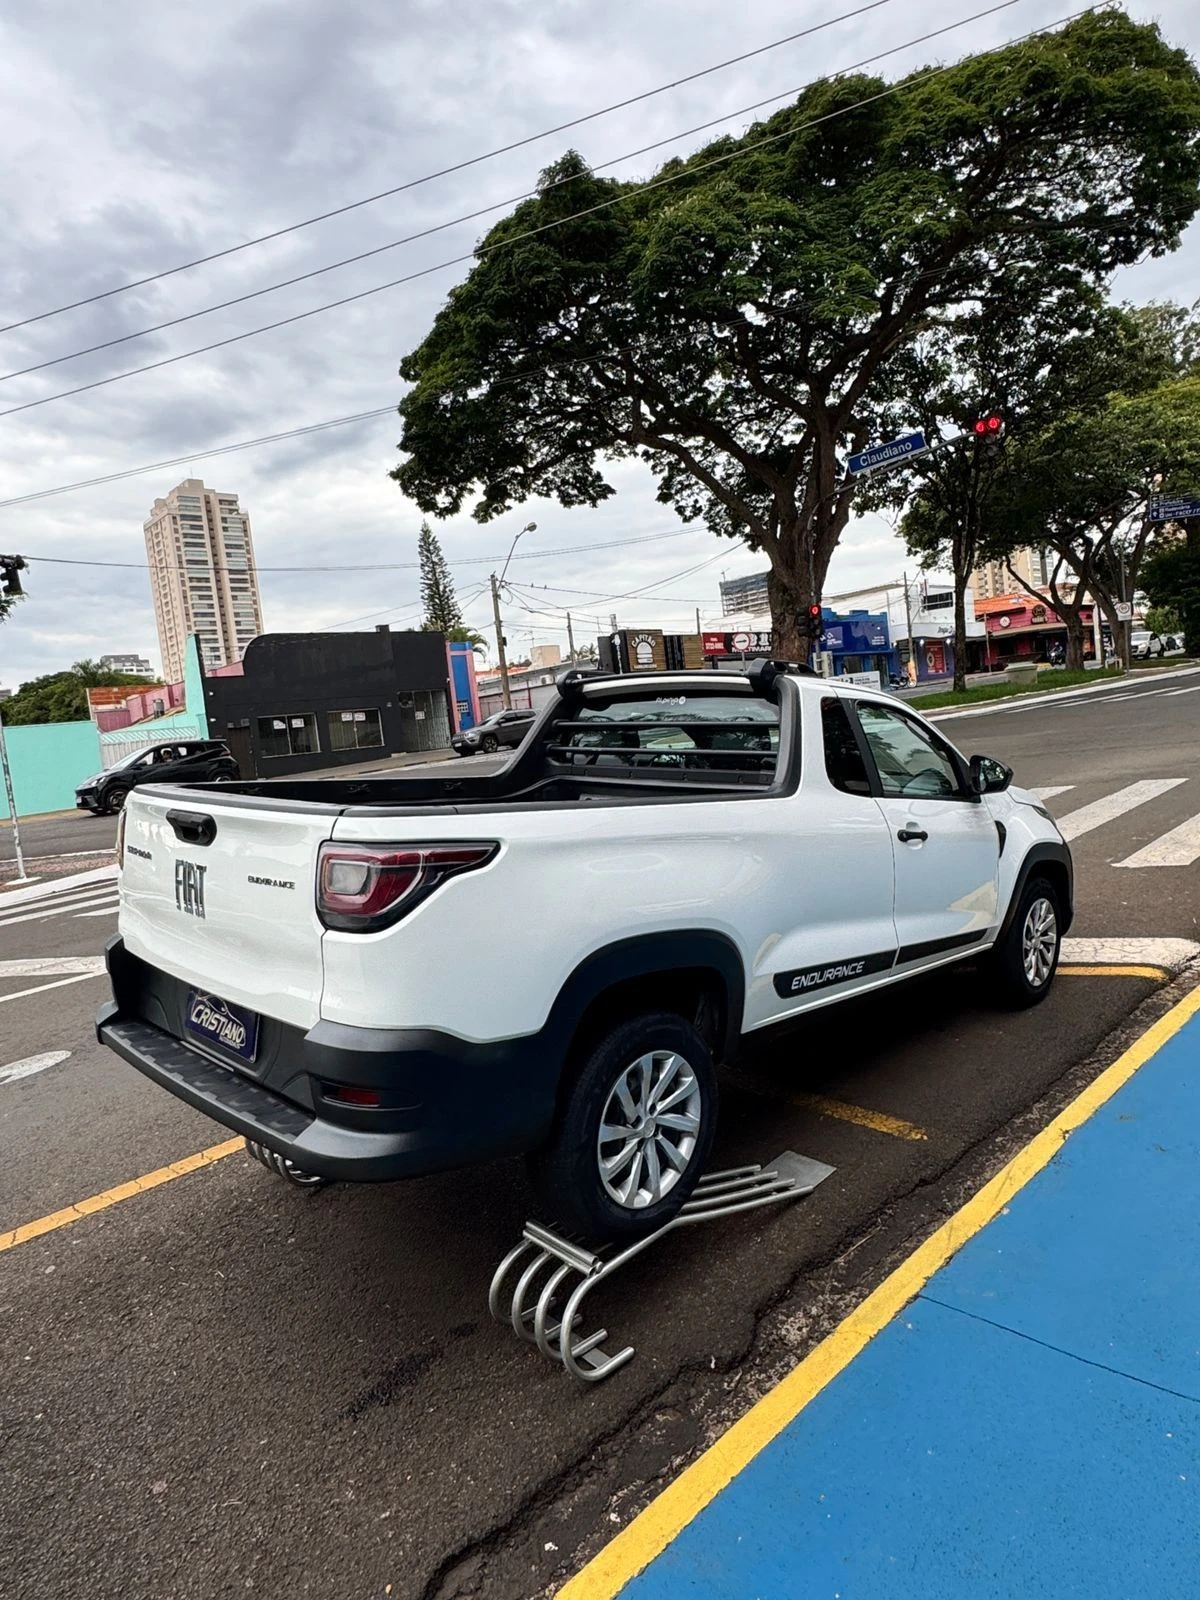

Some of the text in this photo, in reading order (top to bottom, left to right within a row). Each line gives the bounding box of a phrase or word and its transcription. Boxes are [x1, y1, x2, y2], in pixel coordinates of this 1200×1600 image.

[859, 442, 912, 466] Claudiano
[175, 859, 207, 919] FIAT
[247, 875, 295, 890] ENDURANCE
[790, 960, 866, 991] ENDURANCE
[191, 1004, 244, 1043] CRISTIANO
